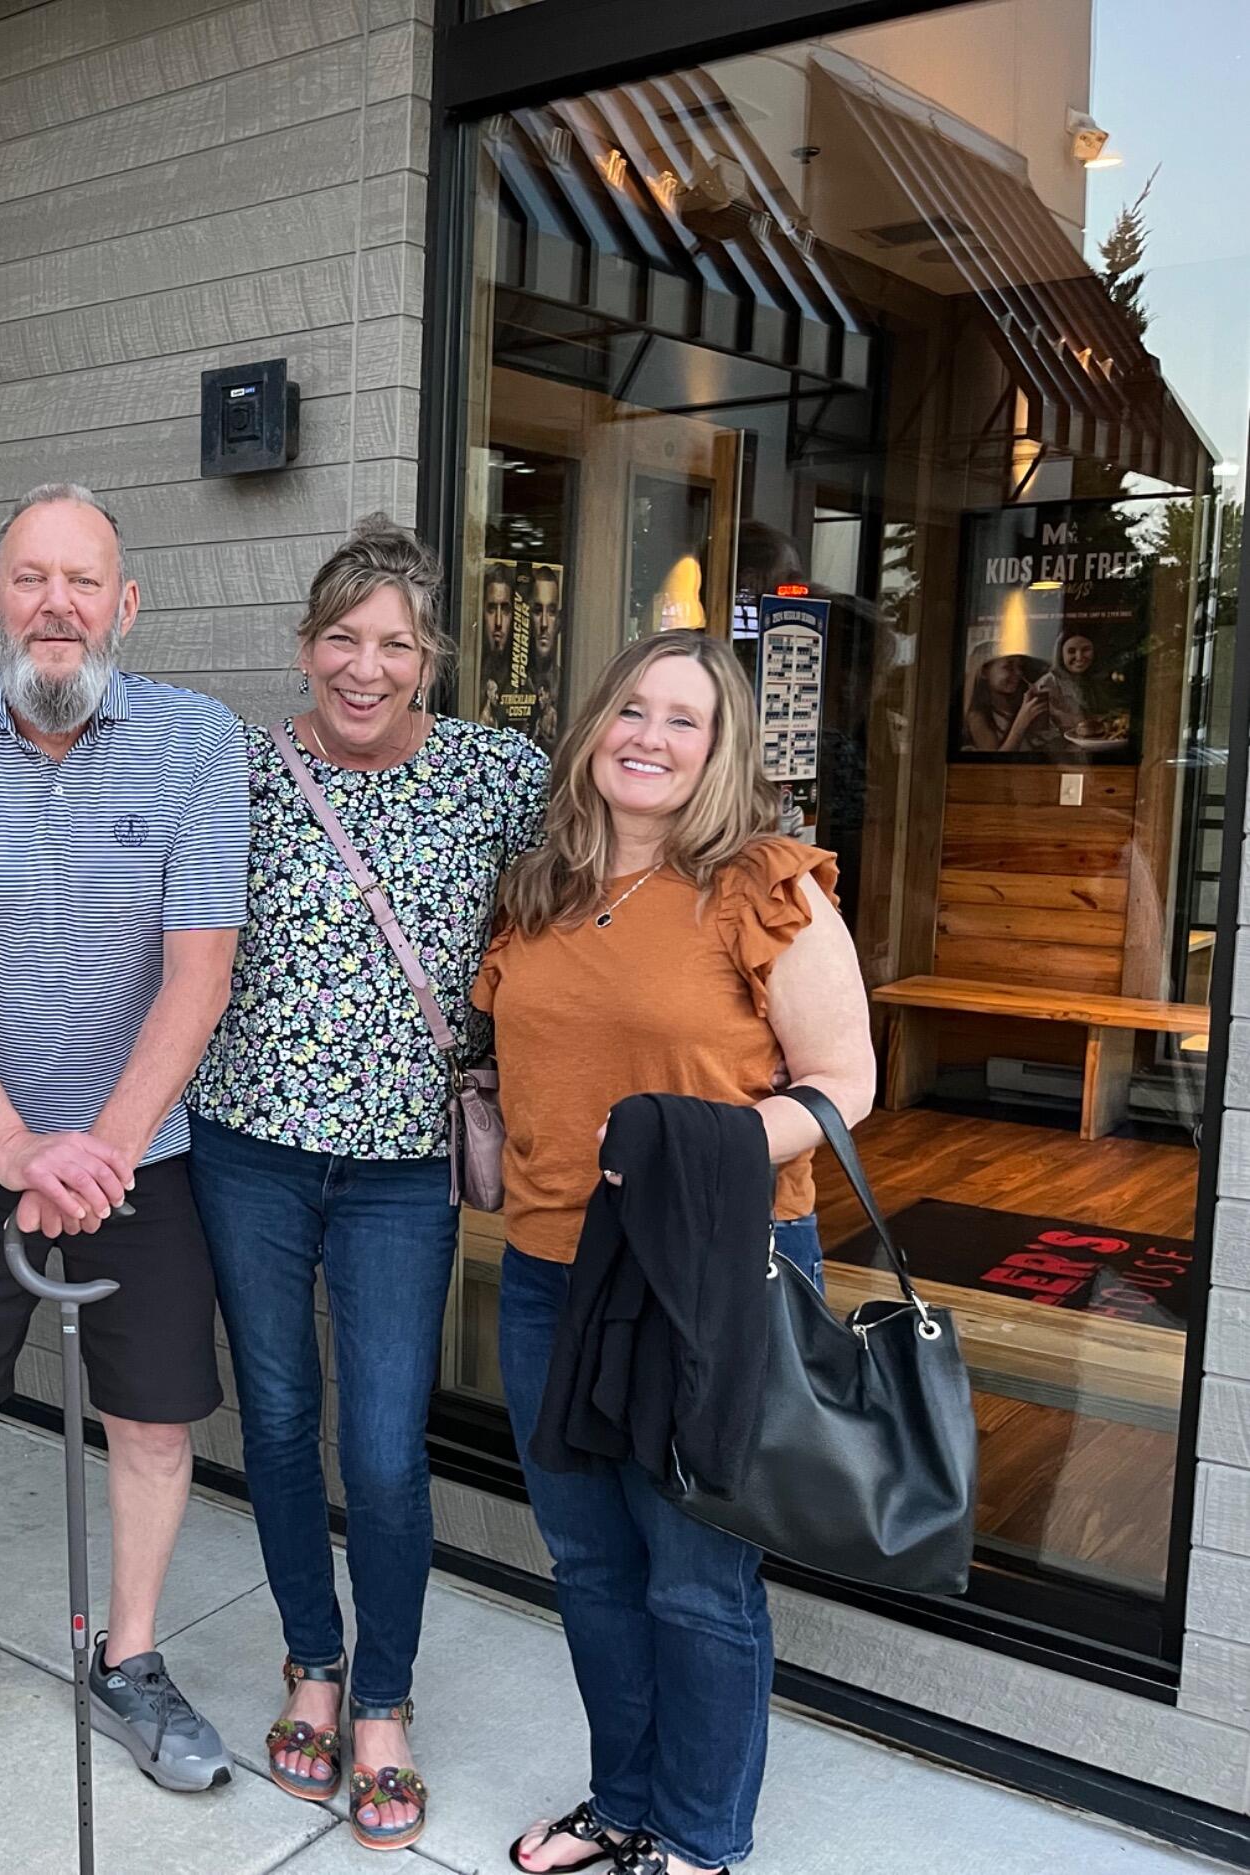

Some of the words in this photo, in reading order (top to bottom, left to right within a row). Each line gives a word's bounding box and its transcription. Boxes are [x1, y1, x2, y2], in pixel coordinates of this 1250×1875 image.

[986, 555, 1034, 585] KIDS
[1040, 553, 1079, 582] EAT
[1084, 551, 1138, 580] FREE
[511, 592, 524, 688] MAKHACHEV
[519, 602, 531, 680] POIRIER
[508, 706, 531, 717] COSTA
[979, 1230, 1131, 1307] ER'S
